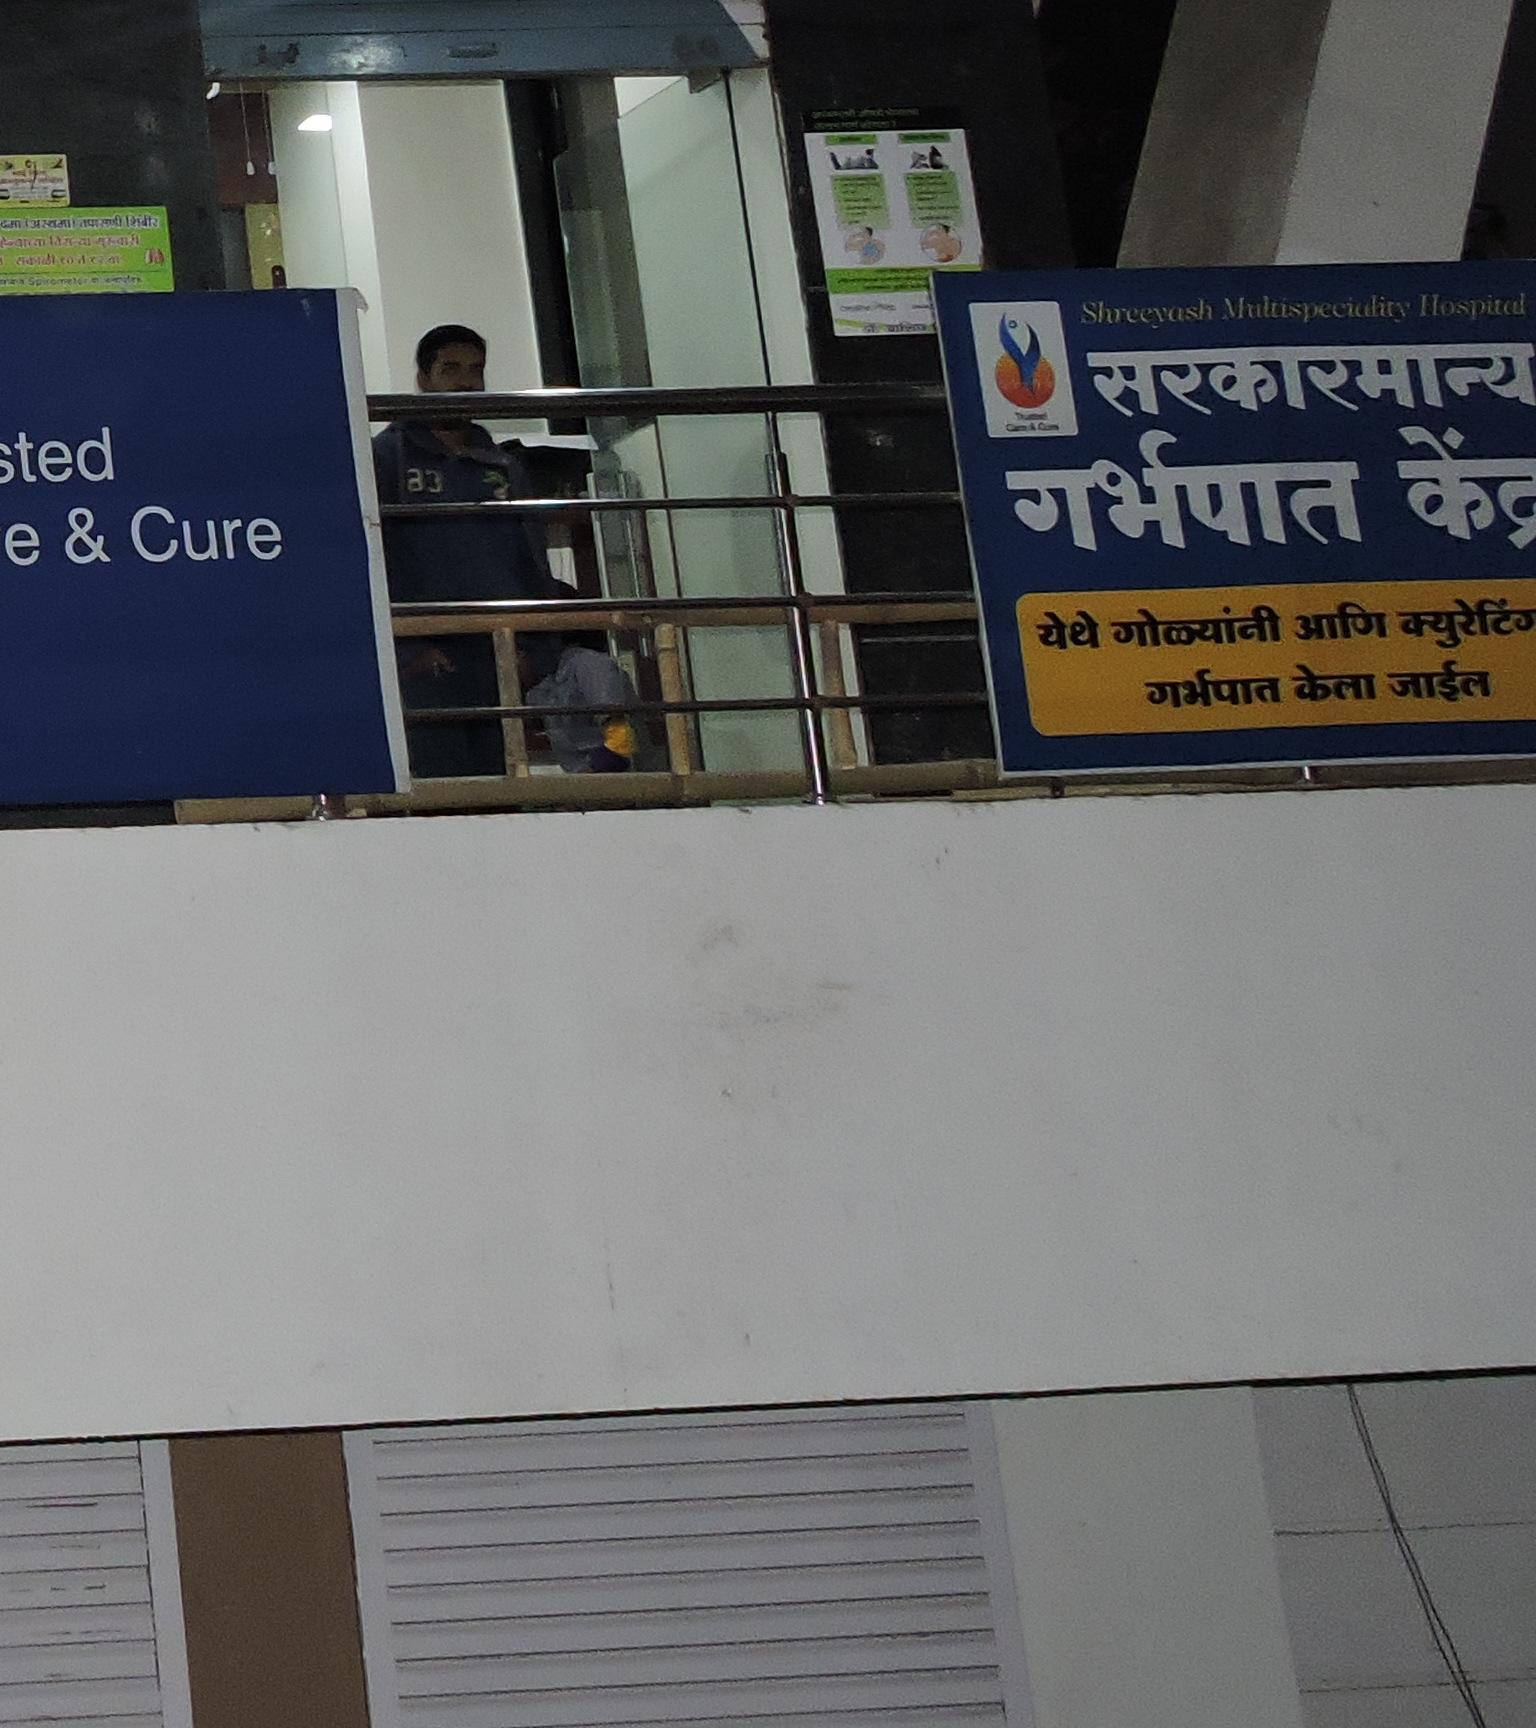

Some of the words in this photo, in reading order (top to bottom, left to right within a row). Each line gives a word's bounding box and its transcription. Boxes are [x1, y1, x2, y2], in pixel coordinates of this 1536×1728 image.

[1081, 298, 1213, 329] Shreeyash
[1418, 292, 1527, 319] Hospital
[1086, 342, 1536, 417] सरकारमान्य
[1005, 428, 1362, 551] गर्भपात
[64, 507, 112, 564] &
[130, 505, 283, 563] Cure
[1036, 610, 1100, 651] येथे
[1295, 601, 1389, 642] आणि
[1144, 668, 1282, 709] गर्भपात
[1292, 664, 1377, 703] केला
[1387, 659, 1493, 702] जाईल
